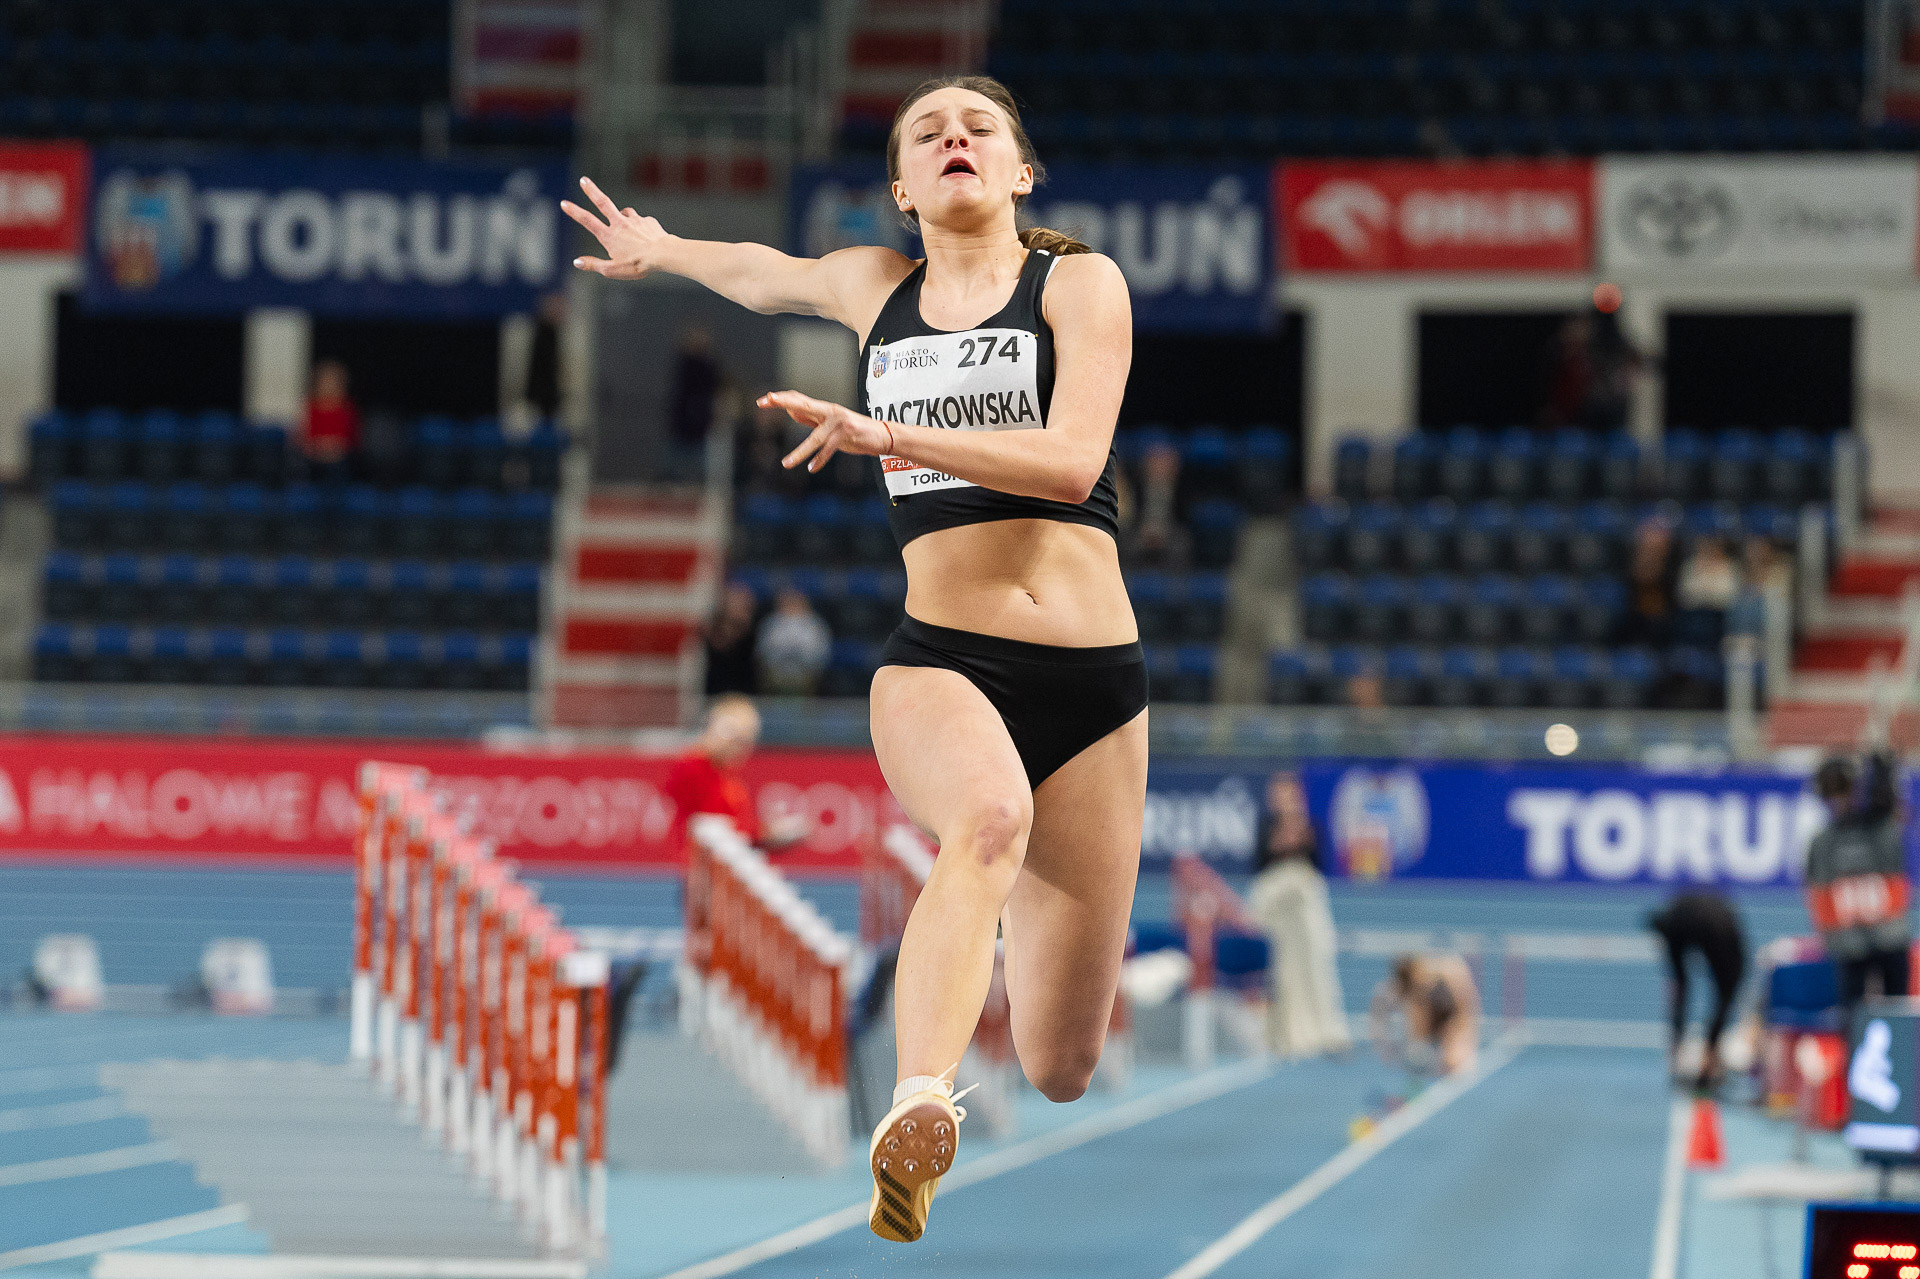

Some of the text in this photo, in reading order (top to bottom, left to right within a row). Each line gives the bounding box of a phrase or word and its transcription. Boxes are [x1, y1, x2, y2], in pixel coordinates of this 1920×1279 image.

[204, 168, 556, 284] TORUŃ
[893, 352, 939, 370] TORUŃ
[896, 348, 929, 358] MIASTO
[958, 336, 1020, 368] 274
[890, 459, 914, 469] PZLA
